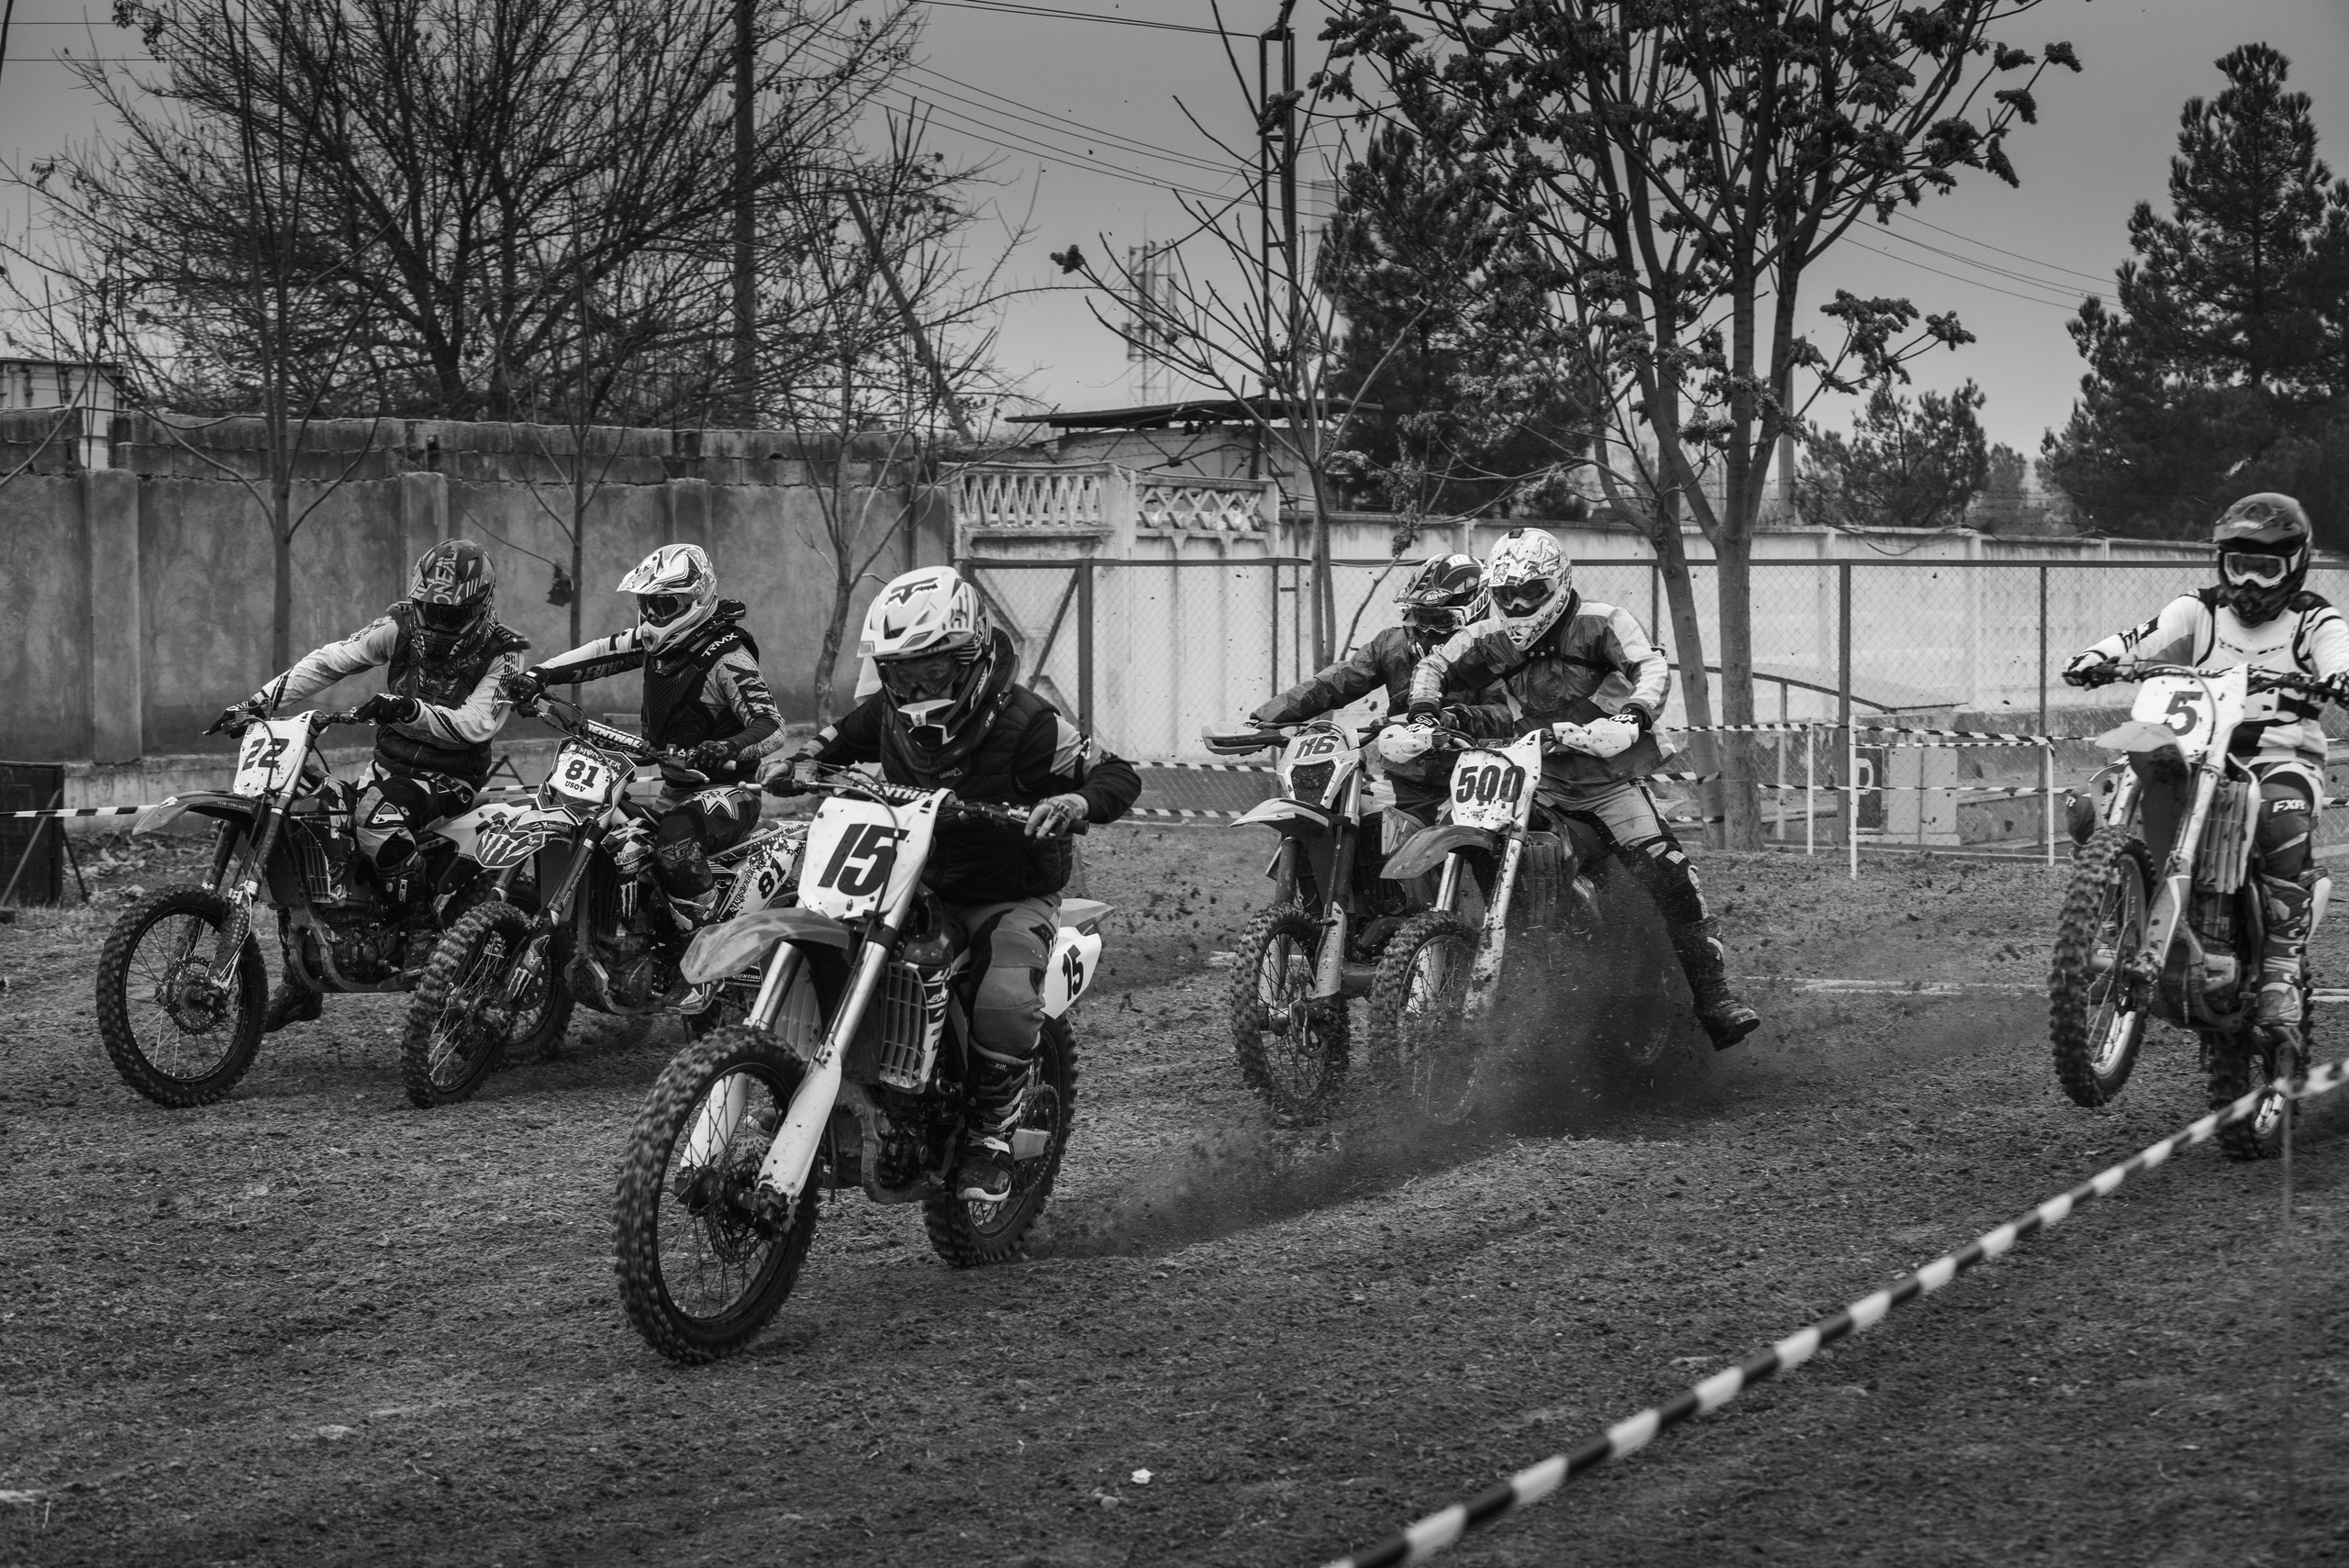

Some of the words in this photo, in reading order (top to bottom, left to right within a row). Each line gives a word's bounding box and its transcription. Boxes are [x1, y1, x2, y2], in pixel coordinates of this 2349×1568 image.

[701, 632, 739, 657] TRMX
[2165, 691, 2203, 737] 5
[242, 738, 290, 772] 22
[1293, 735, 1340, 761] 116
[565, 759, 599, 789] 81
[565, 780, 586, 793] USOV
[1456, 765, 1526, 804] 500
[2272, 799, 2306, 813] FXR
[818, 823, 911, 897] 15
[758, 856, 786, 900] 81
[1063, 944, 1085, 1003] 15
